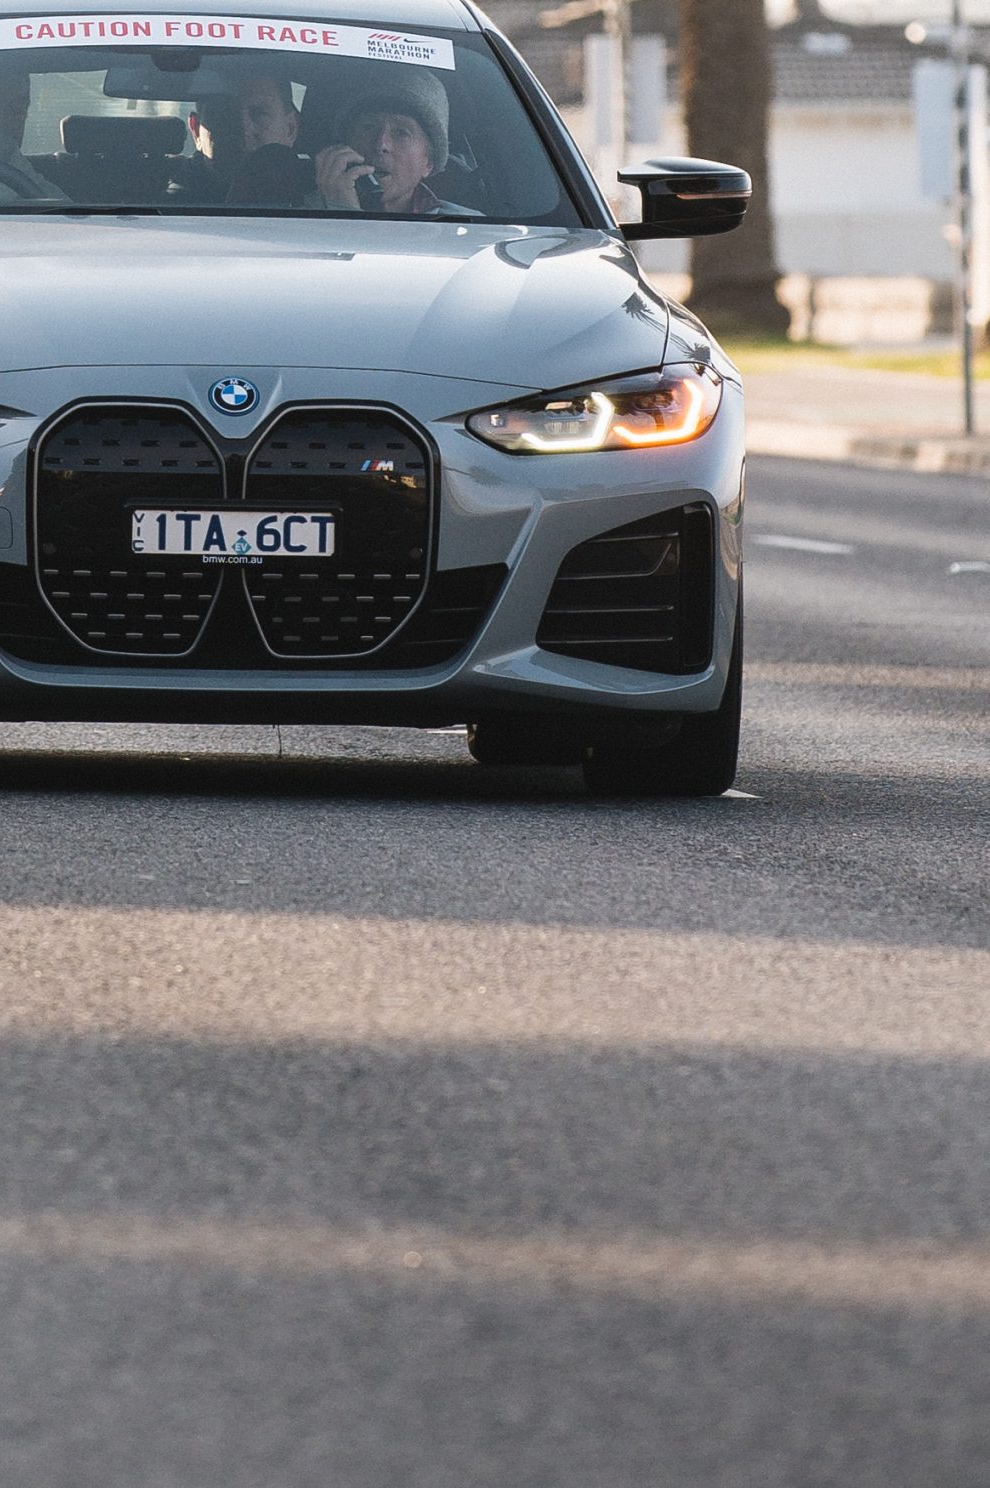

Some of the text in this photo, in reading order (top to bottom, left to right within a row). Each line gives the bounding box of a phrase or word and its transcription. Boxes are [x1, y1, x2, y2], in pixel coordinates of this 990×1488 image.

[15, 21, 340, 47] CAUTION FOOT RACE
[367, 40, 436, 55] MELBOURNE
[367, 46, 430, 60] MARATHON
[368, 52, 403, 60] FESTIVAL
[132, 513, 145, 552] VIC
[234, 542, 249, 552] EV
[202, 555, 263, 565] bmw.com.au
